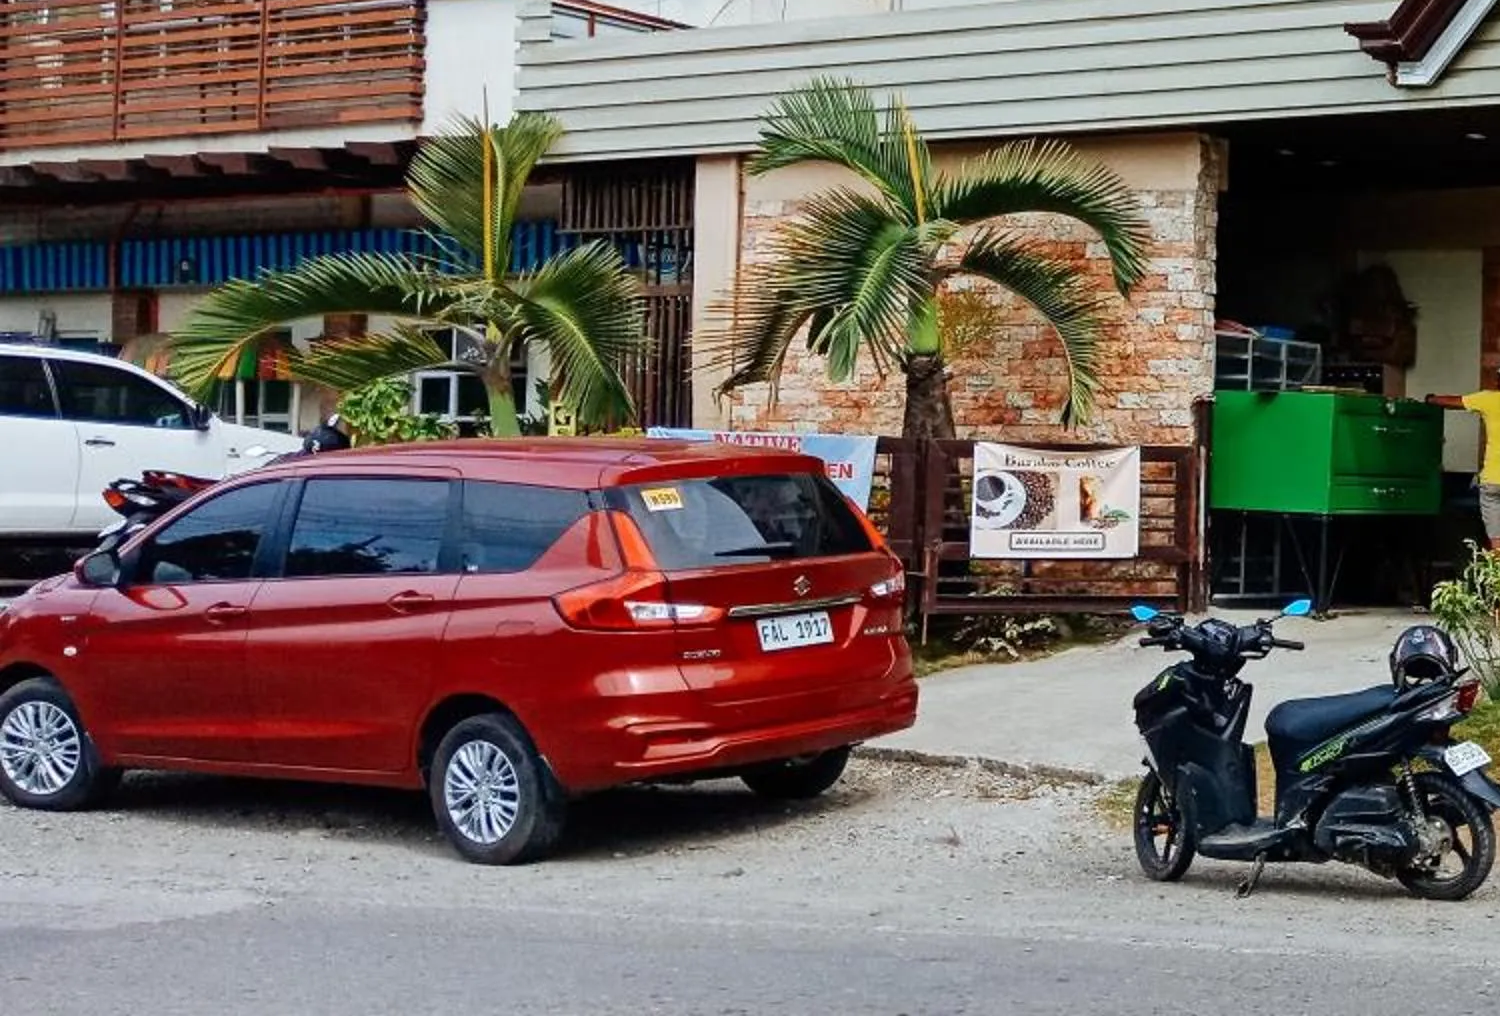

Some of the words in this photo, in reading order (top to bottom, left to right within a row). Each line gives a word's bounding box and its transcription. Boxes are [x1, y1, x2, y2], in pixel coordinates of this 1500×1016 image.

[826, 463, 853, 479] EN
[761, 623, 789, 644] FAL
[795, 617, 828, 639] 1917
